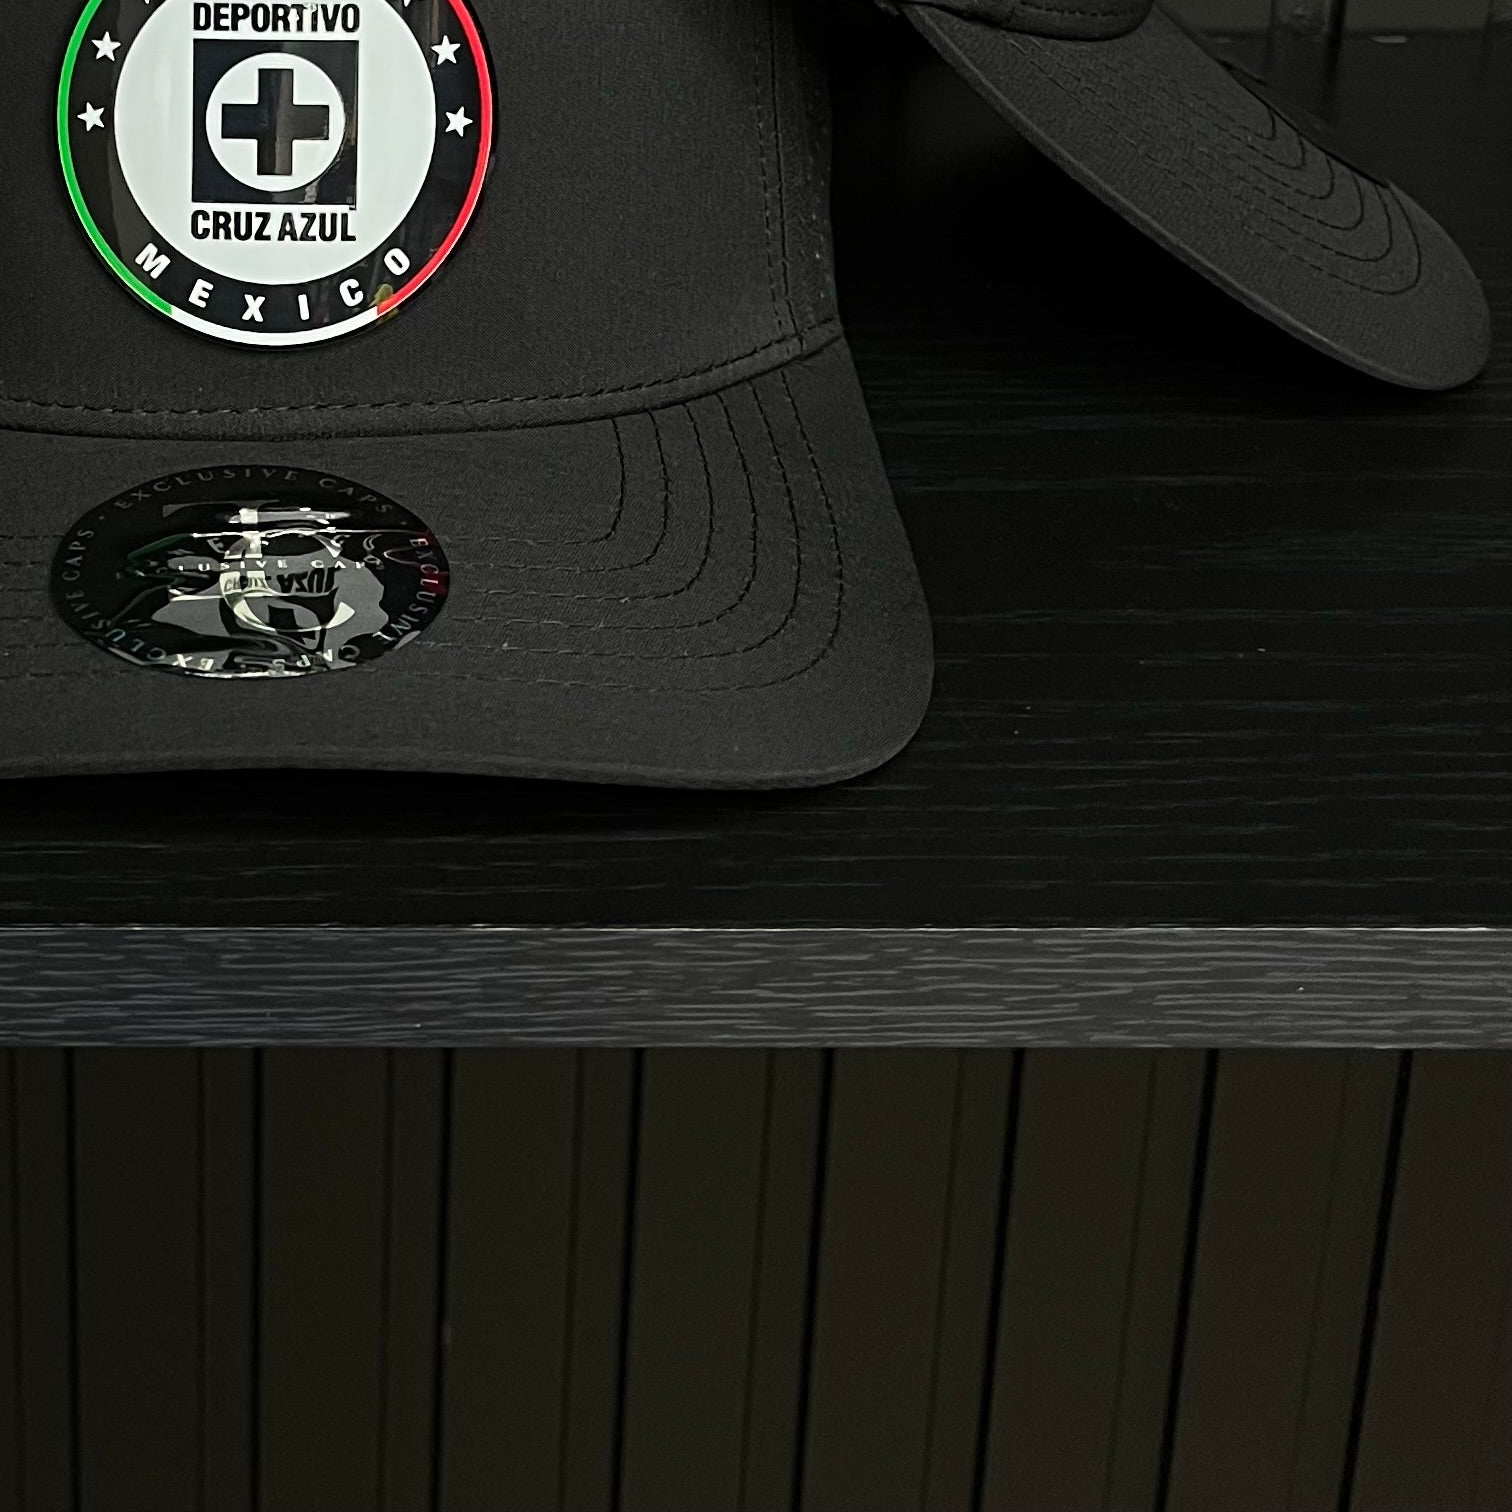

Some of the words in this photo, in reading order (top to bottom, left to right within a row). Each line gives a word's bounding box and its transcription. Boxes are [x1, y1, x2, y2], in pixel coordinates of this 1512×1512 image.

[192, 2, 361, 34] DEPORTIVO
[190, 210, 272, 242] CRUZ
[277, 211, 357, 243] AZUL
[134, 240, 412, 324] MEXICO
[112, 467, 301, 511] EXCLUSIVE
[317, 477, 395, 515] CAPS
[62, 525, 96, 584] CAPS
